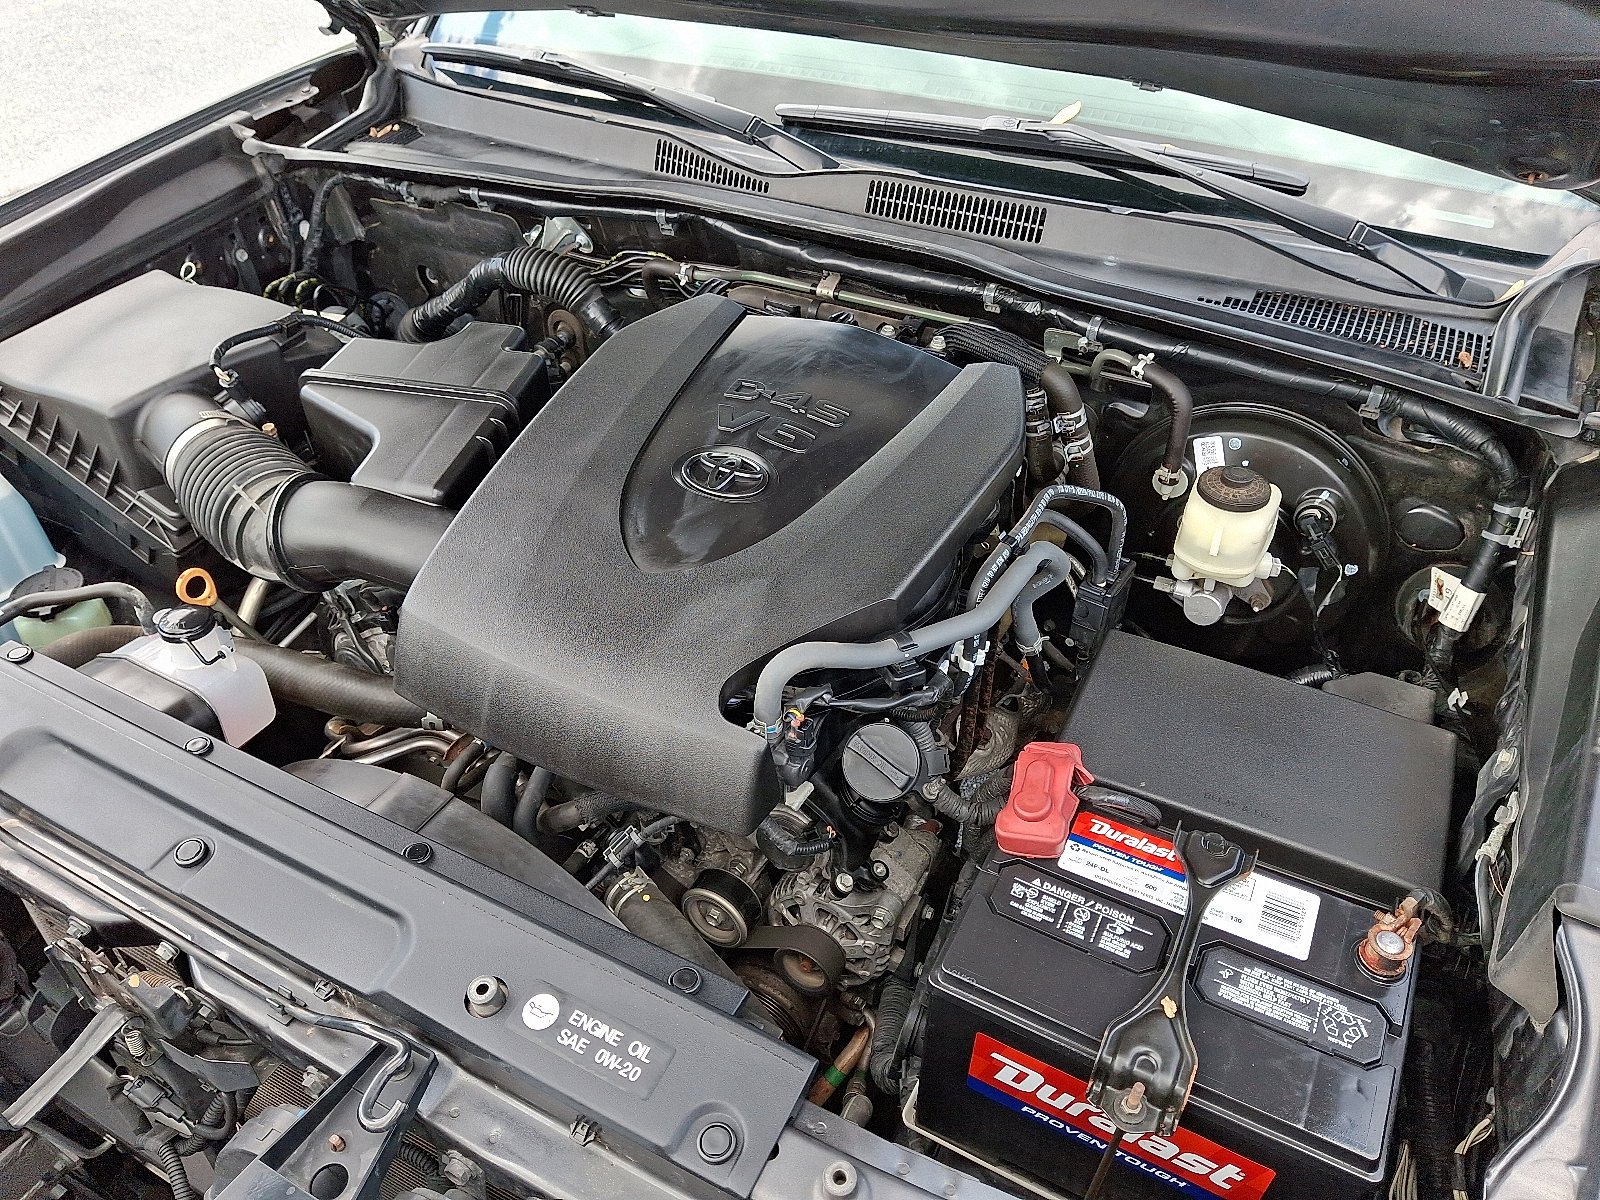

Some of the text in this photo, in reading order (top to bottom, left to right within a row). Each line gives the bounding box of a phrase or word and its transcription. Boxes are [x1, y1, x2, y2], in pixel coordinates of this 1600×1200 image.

[717, 403, 818, 454] V6
[723, 378, 850, 428] D-4S
[1090, 818, 1177, 862] Duralast
[1092, 843, 1130, 861] PROVEN
[1131, 857, 1165, 872] TOUGH
[1043, 881, 1086, 906] DANGER
[1094, 903, 1135, 924] POISON
[556, 1028, 642, 1082] SAE 0W-20
[567, 1009, 651, 1064] ENGINE OIL
[990, 1052, 1246, 1190] Duraast
[1021, 1105, 1188, 1188] PROVEN TOUGH
